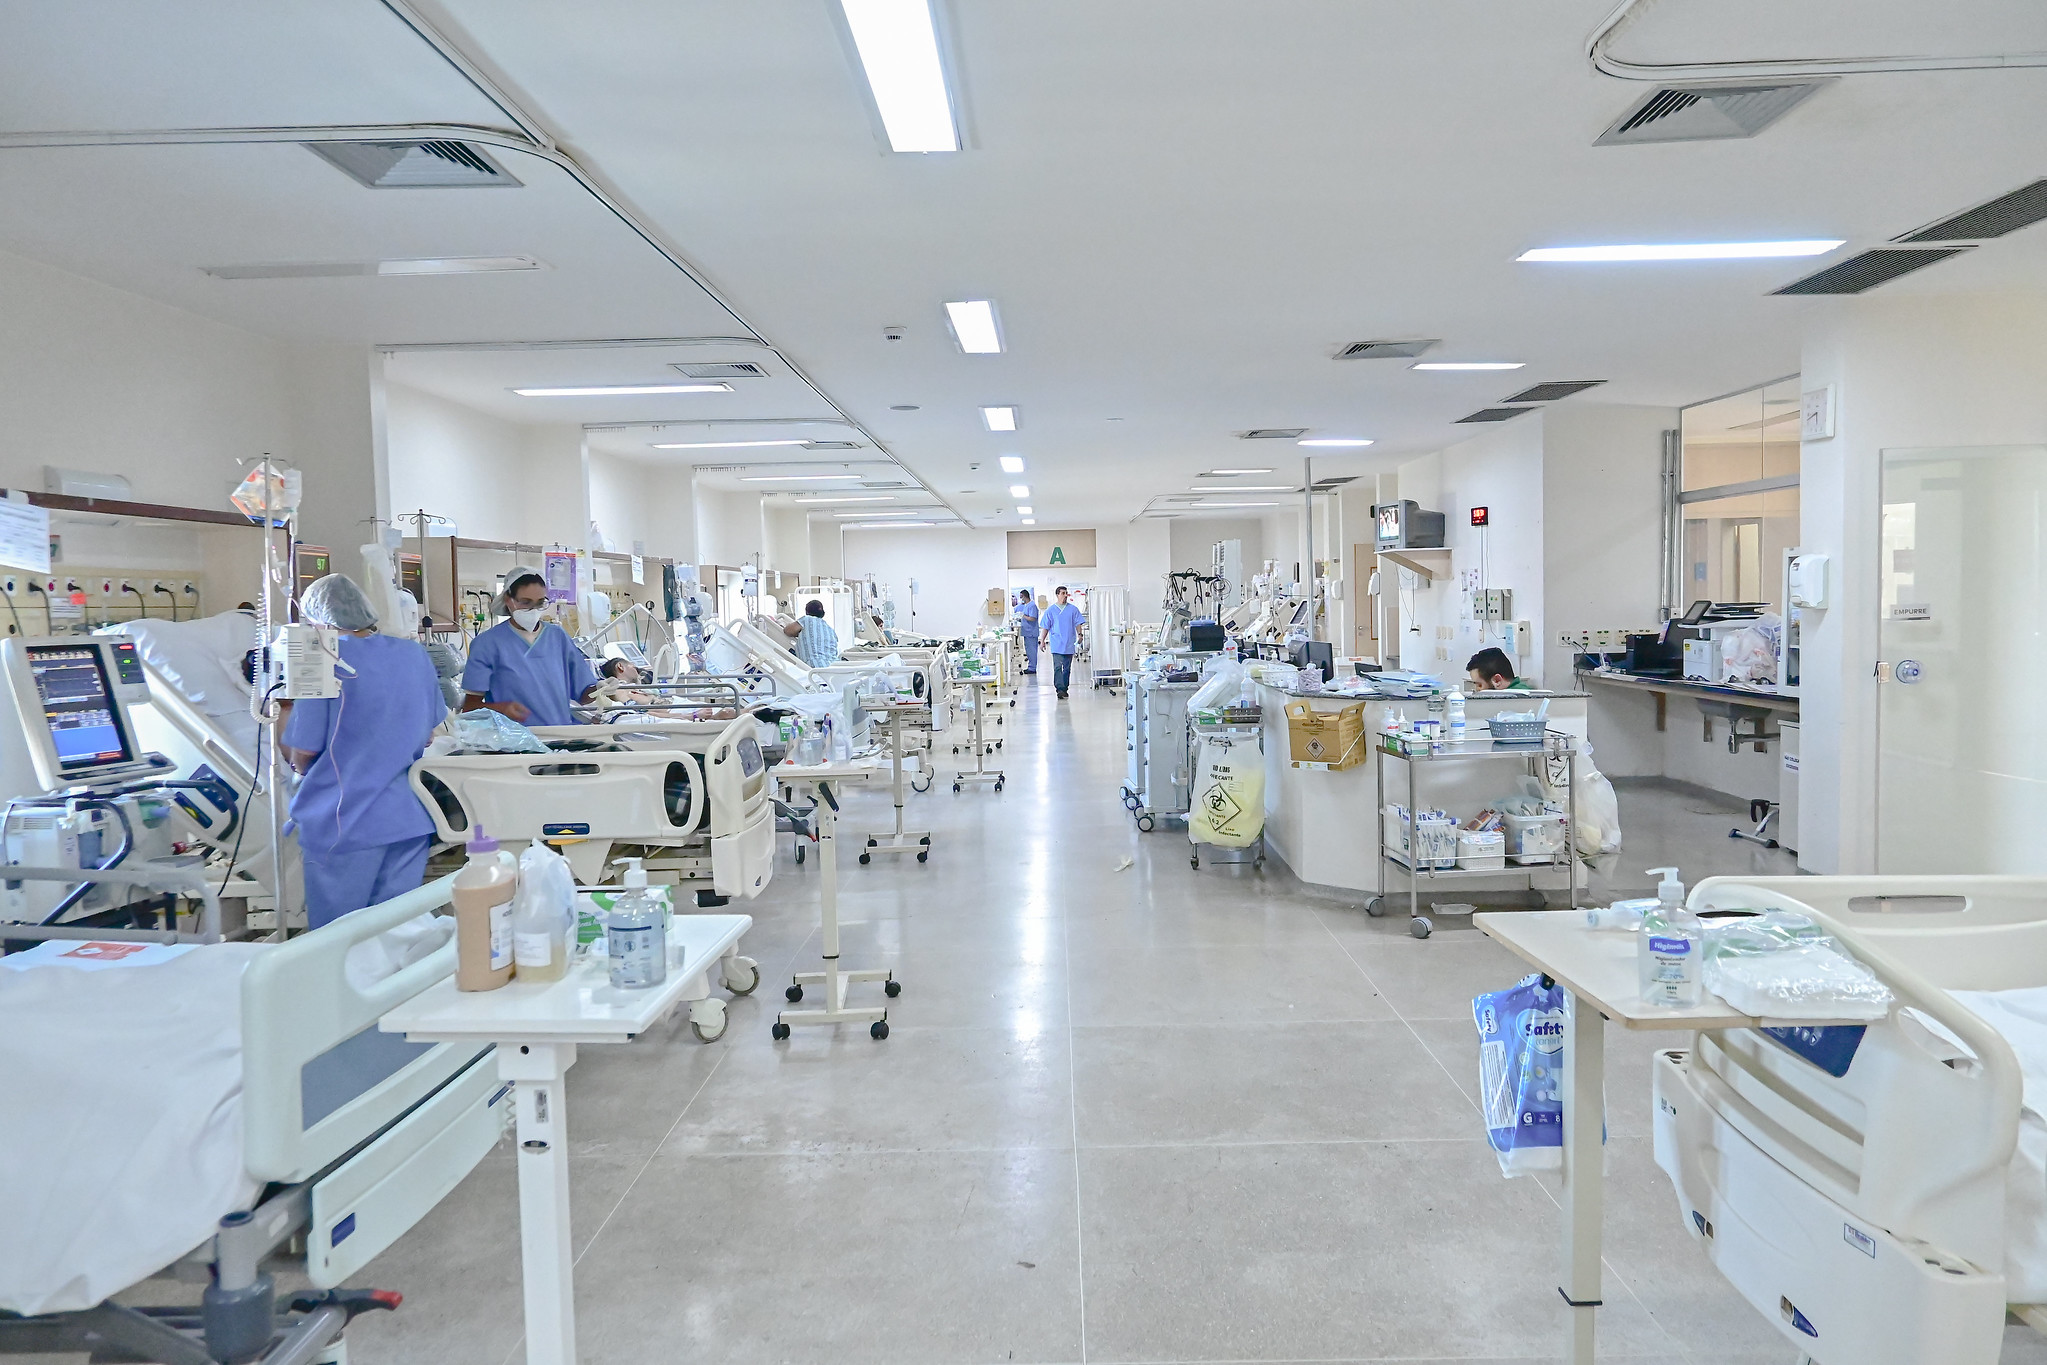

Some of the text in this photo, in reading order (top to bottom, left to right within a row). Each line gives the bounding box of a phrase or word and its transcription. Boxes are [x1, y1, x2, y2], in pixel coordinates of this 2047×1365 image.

[1049, 546, 1066, 564] A
[317, 559, 326, 570] 97
[1894, 608, 1927, 616] EMPURRE
[1523, 1112, 1533, 1124] G
